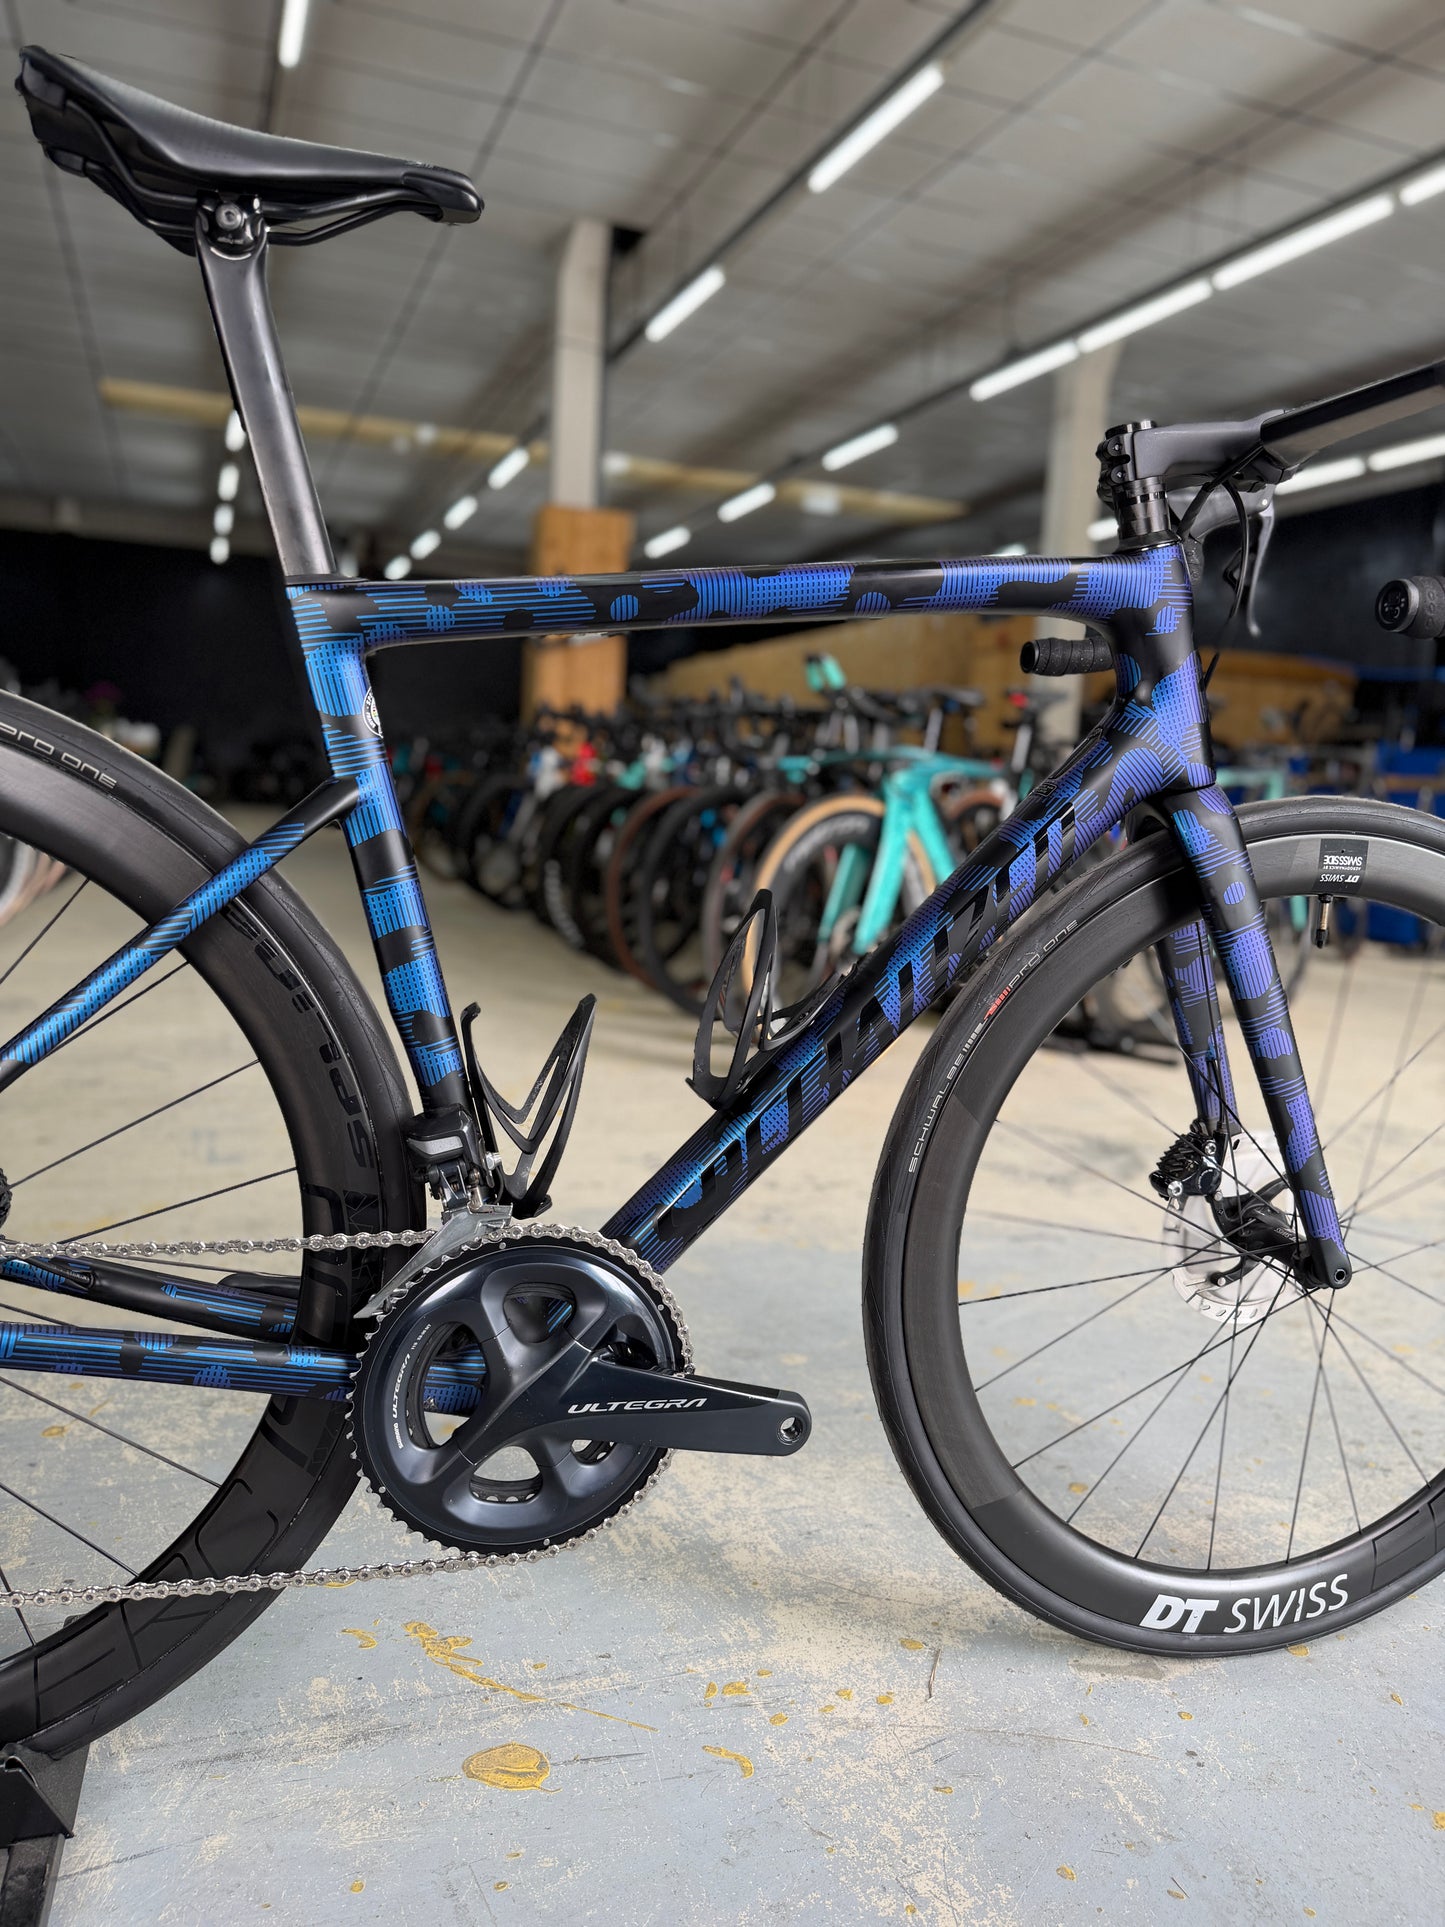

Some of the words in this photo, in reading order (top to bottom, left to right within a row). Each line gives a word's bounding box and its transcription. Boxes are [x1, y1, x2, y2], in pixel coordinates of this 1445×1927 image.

[1319, 873, 1345, 883] SWISS
[1344, 874, 1361, 883] DT
[908, 1053, 964, 1173] SCHWALBE
[392, 1353, 411, 1419] ULTEGRA
[567, 1398, 708, 1414] ULTEGRA
[1139, 1594, 1220, 1634] DT
[1223, 1573, 1349, 1634] SWISS
